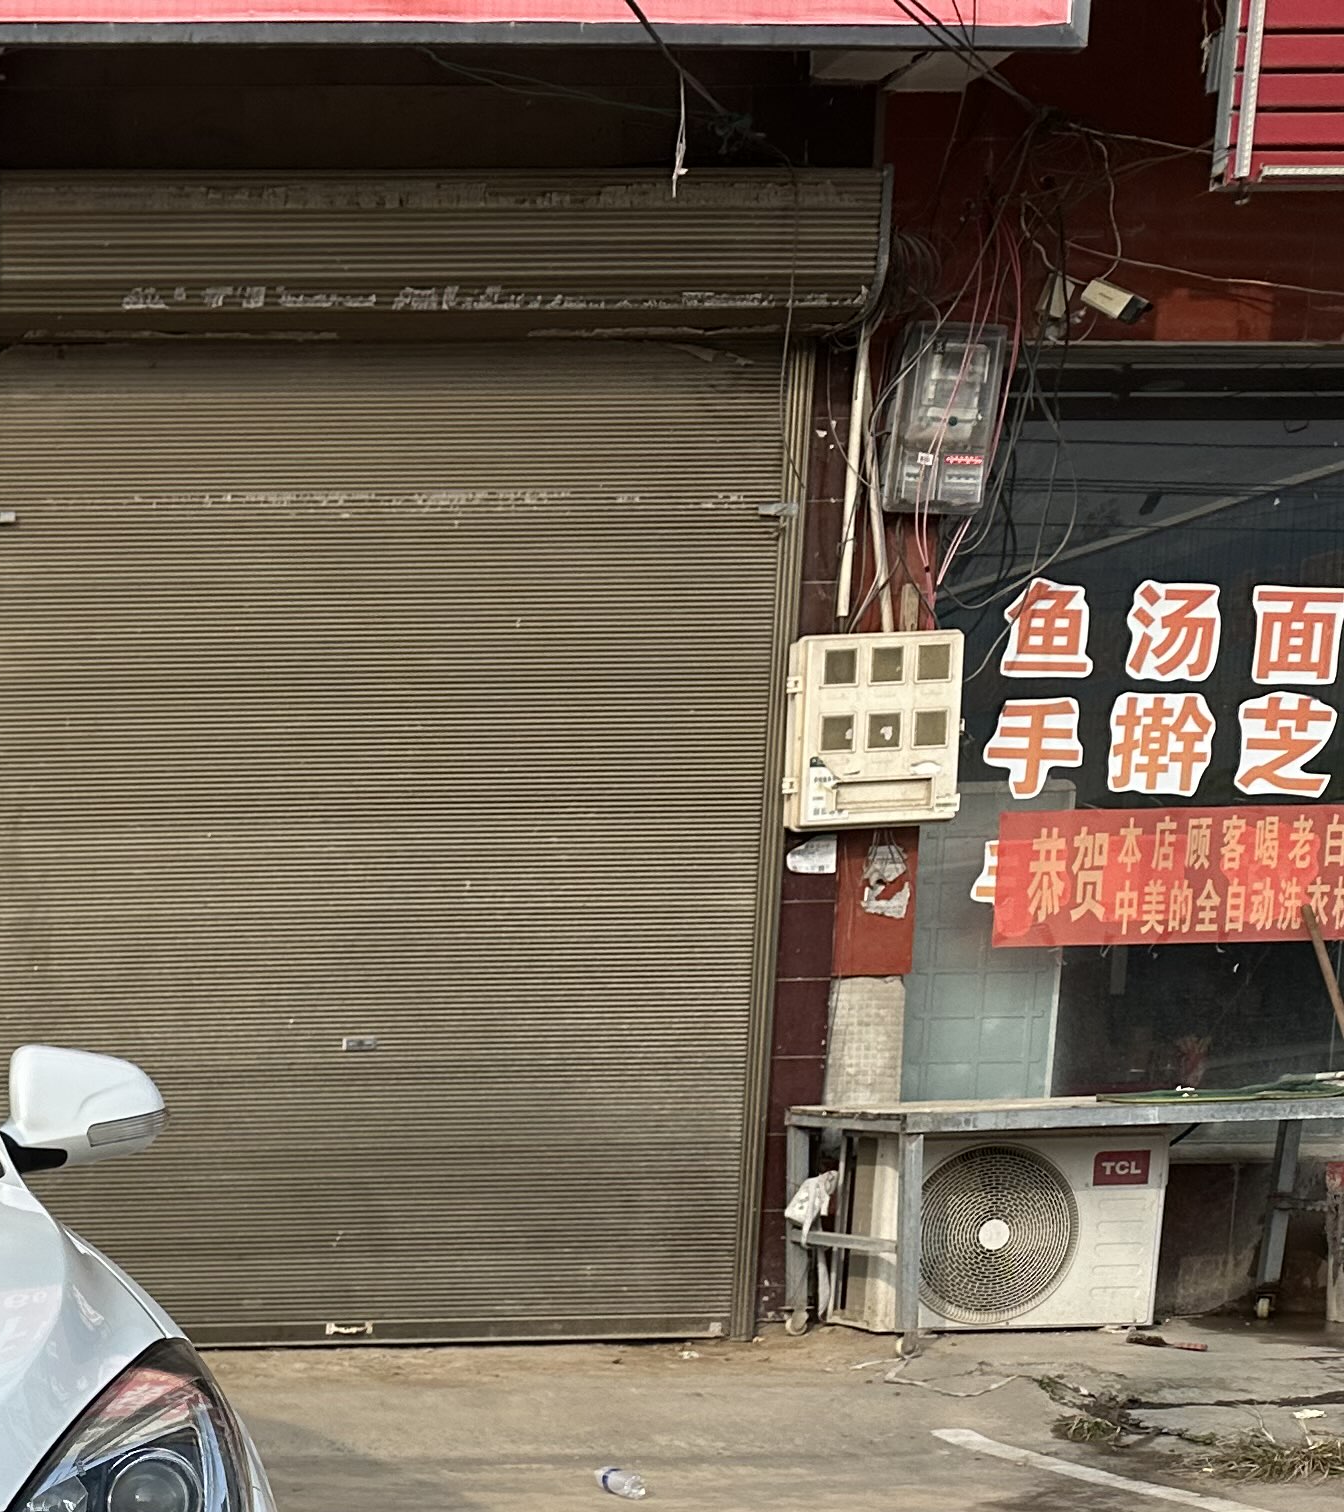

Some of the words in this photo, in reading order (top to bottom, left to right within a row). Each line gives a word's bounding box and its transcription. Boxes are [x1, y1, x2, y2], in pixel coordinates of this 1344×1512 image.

[1004, 579, 1344, 680] 鱼汤面
[987, 696, 1333, 795] 手擀芝
[1027, 826, 1110, 924] 恭贺
[1117, 814, 1344, 872] 本店顾客喝老白
[1101, 1161, 1142, 1175] TCL
